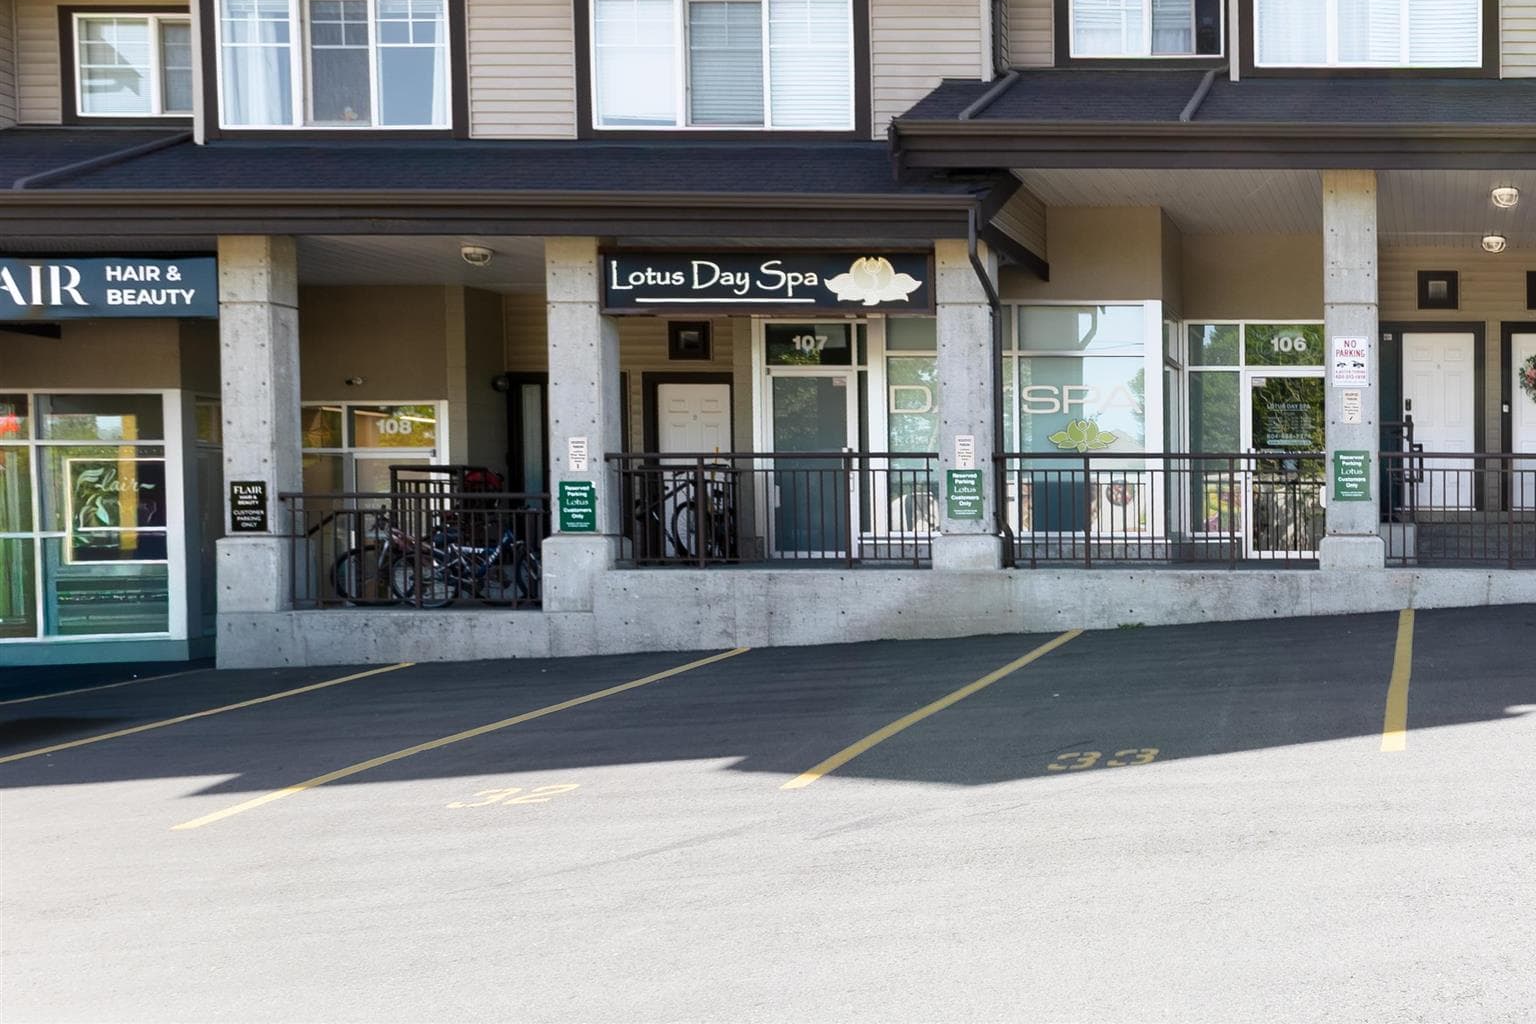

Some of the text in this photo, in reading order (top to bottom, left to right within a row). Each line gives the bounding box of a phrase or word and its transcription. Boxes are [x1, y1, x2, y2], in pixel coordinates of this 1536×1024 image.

[105, 265, 182, 282] HAIR &
[611, 260, 818, 297] Lotus Day Spa
[106, 288, 195, 305] BEAUTY
[792, 335, 828, 351] 107
[1270, 336, 1307, 352] 106
[1344, 340, 1357, 348] NO
[1335, 349, 1366, 358] PARKING
[1021, 384, 1143, 414] SPA
[376, 419, 412, 434] 108
[75, 467, 157, 495] Flair
[233, 486, 263, 494] FLAIR
[1047, 748, 1160, 771] 33
[446, 783, 581, 808] 32
